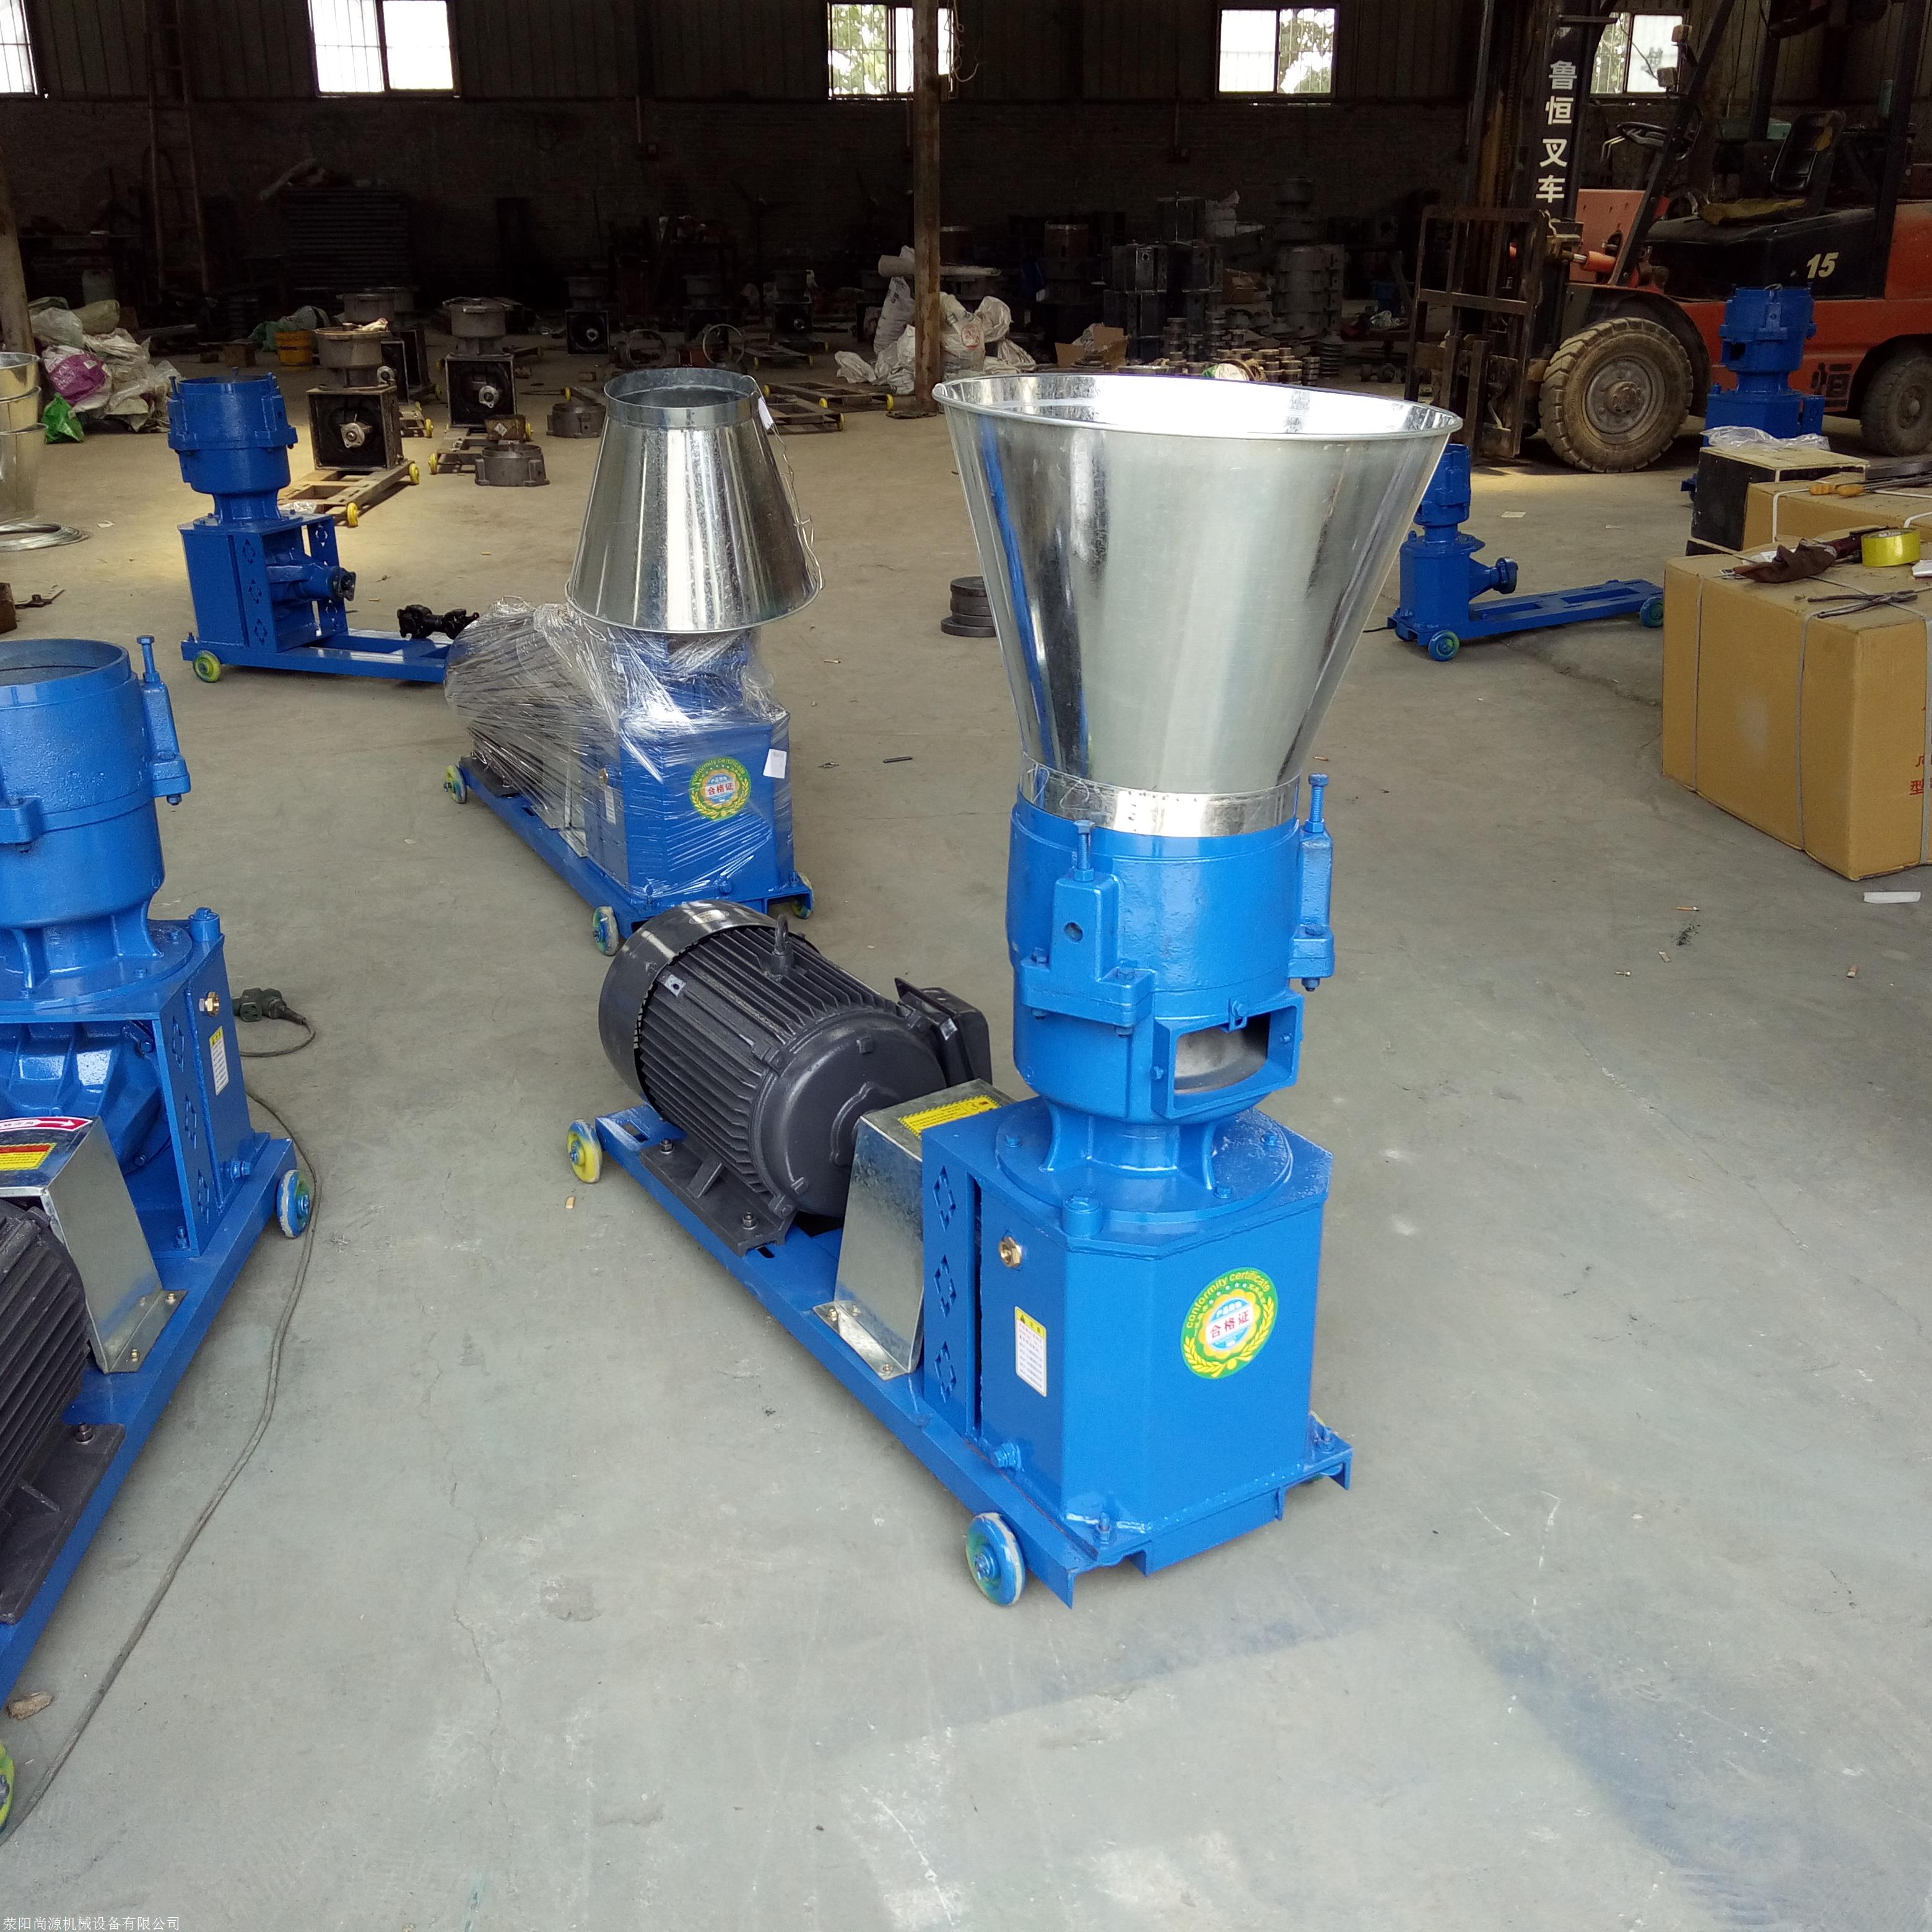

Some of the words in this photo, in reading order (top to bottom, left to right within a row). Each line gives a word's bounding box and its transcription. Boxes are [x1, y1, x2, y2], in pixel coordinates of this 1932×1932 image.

[1535, 60, 1577, 203] 鲁恒叉车
[1806, 252, 1839, 279] 15
[707, 782, 734, 796] 合格证
[1210, 1310, 1250, 1339] 合格证
